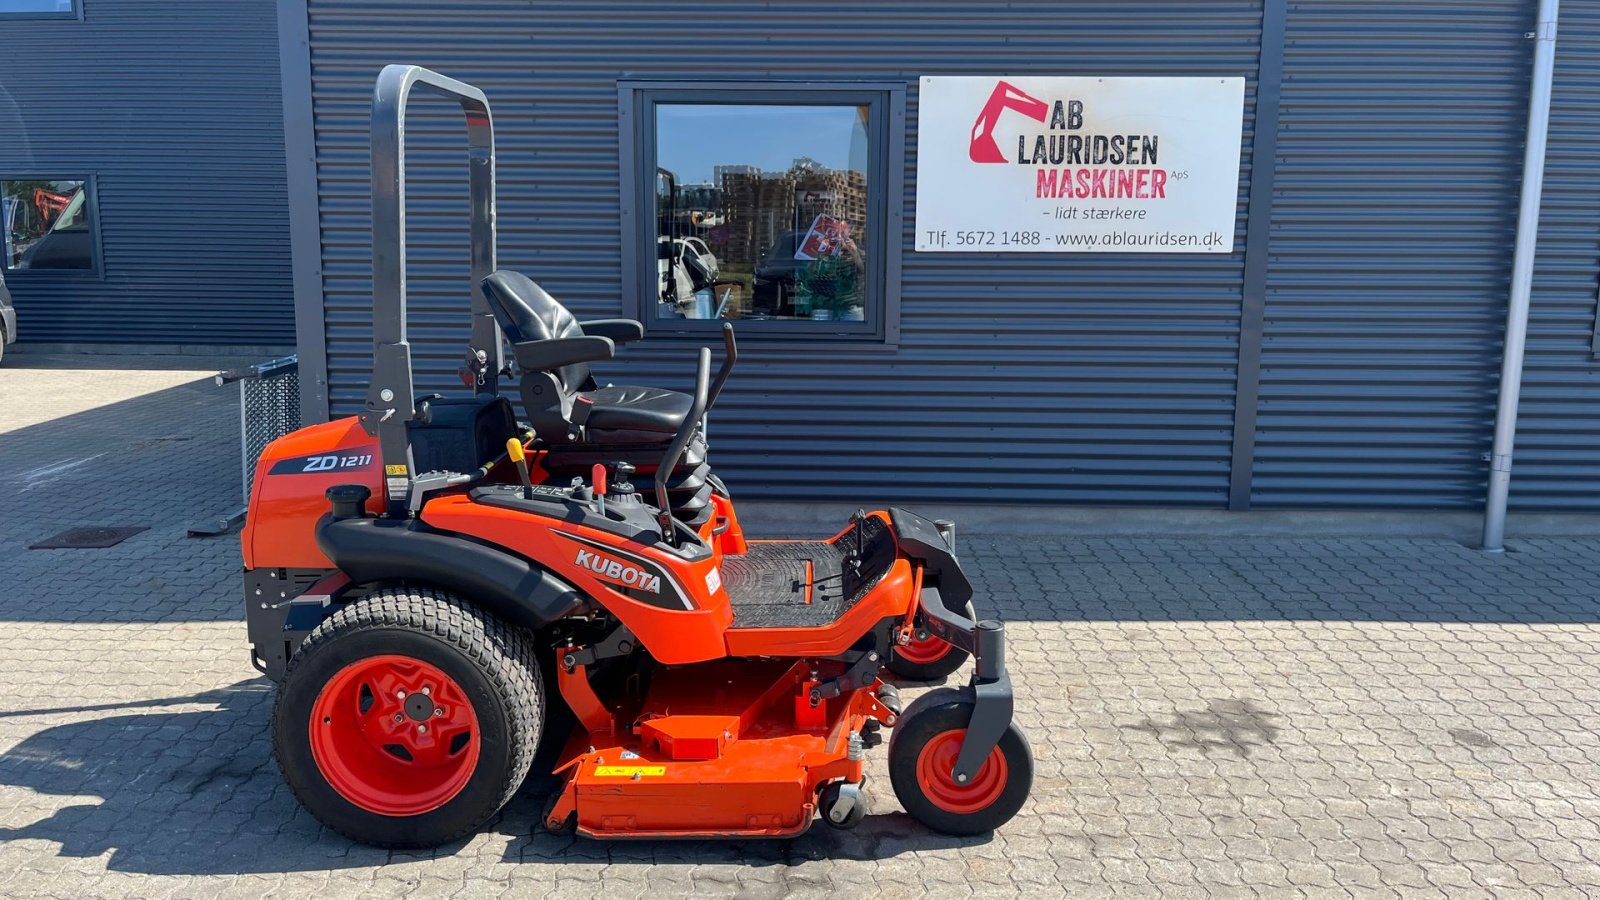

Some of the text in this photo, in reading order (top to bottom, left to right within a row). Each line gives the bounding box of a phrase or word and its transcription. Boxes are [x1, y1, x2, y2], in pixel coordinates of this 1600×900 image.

[1050, 100, 1083, 130] AB
[1018, 135, 1158, 165] LAURIDSEN
[1036, 169, 1167, 199] MASKINER
[1170, 170, 1189, 181] ApS
[1055, 206, 1078, 220] lidt
[1082, 206, 1147, 220] stærkere
[926, 231, 951, 248] Tlf.
[956, 231, 995, 245] 5672
[1001, 231, 1040, 246] 1488
[1055, 231, 1223, 247] www.ablauridsen.dk
[303, 454, 372, 472] ZD 1211
[574, 549, 661, 594] KUBOTA
